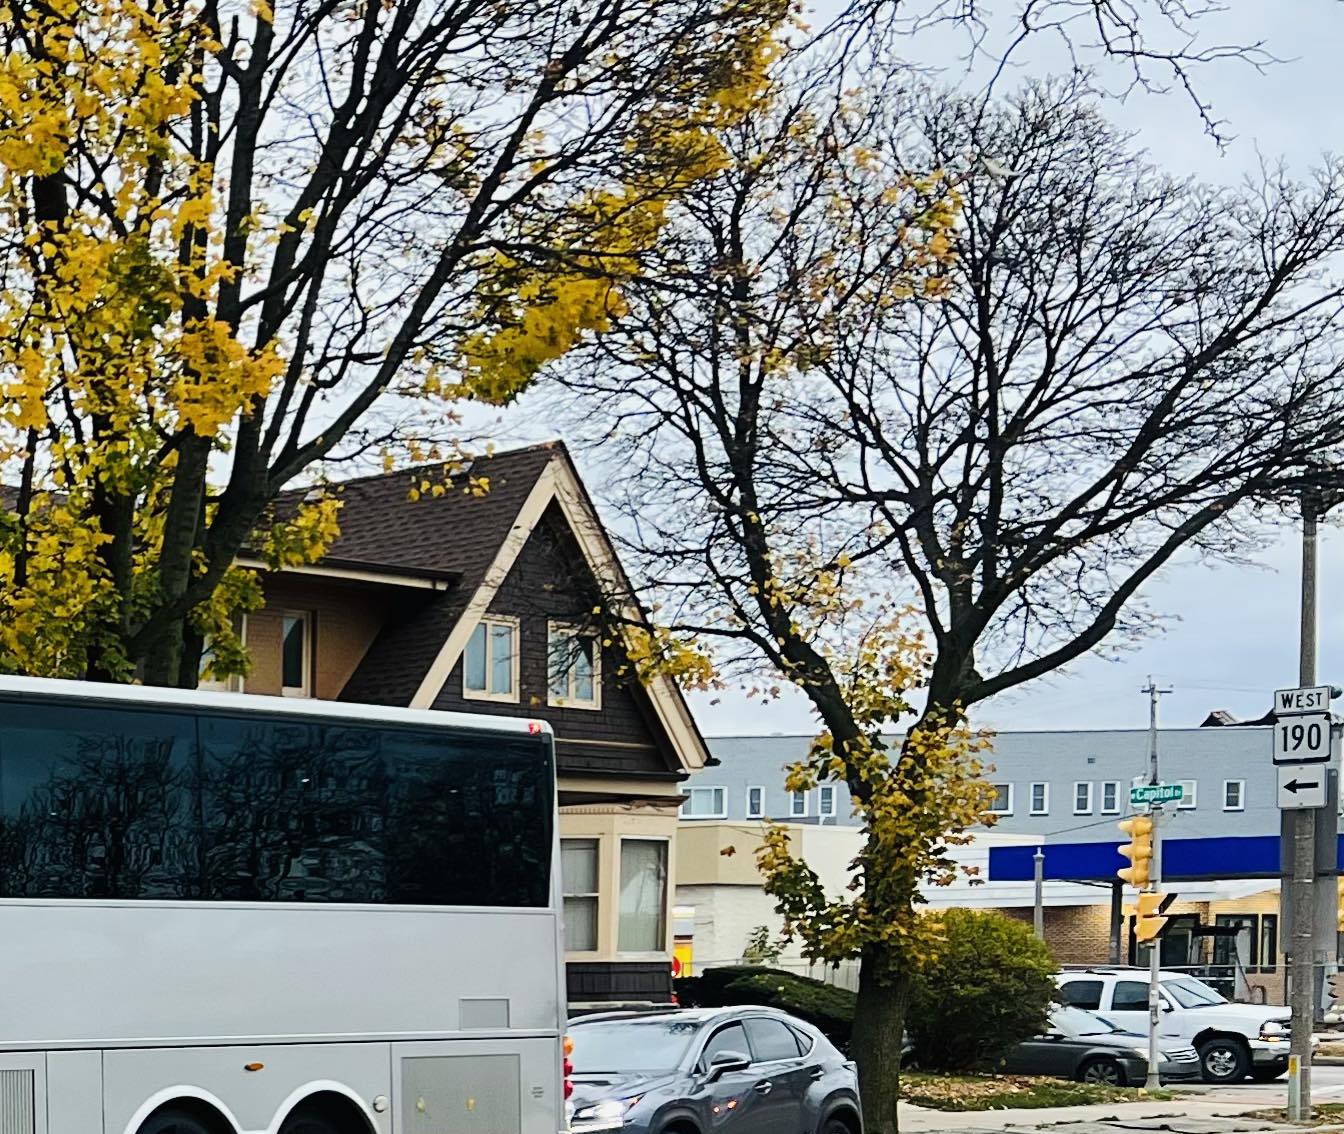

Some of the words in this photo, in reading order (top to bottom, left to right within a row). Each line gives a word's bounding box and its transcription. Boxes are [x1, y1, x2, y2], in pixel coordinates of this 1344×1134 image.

[1281, 692, 1322, 709] WEST
[1281, 723, 1321, 752] 190
[1136, 786, 1174, 801] Capitol
